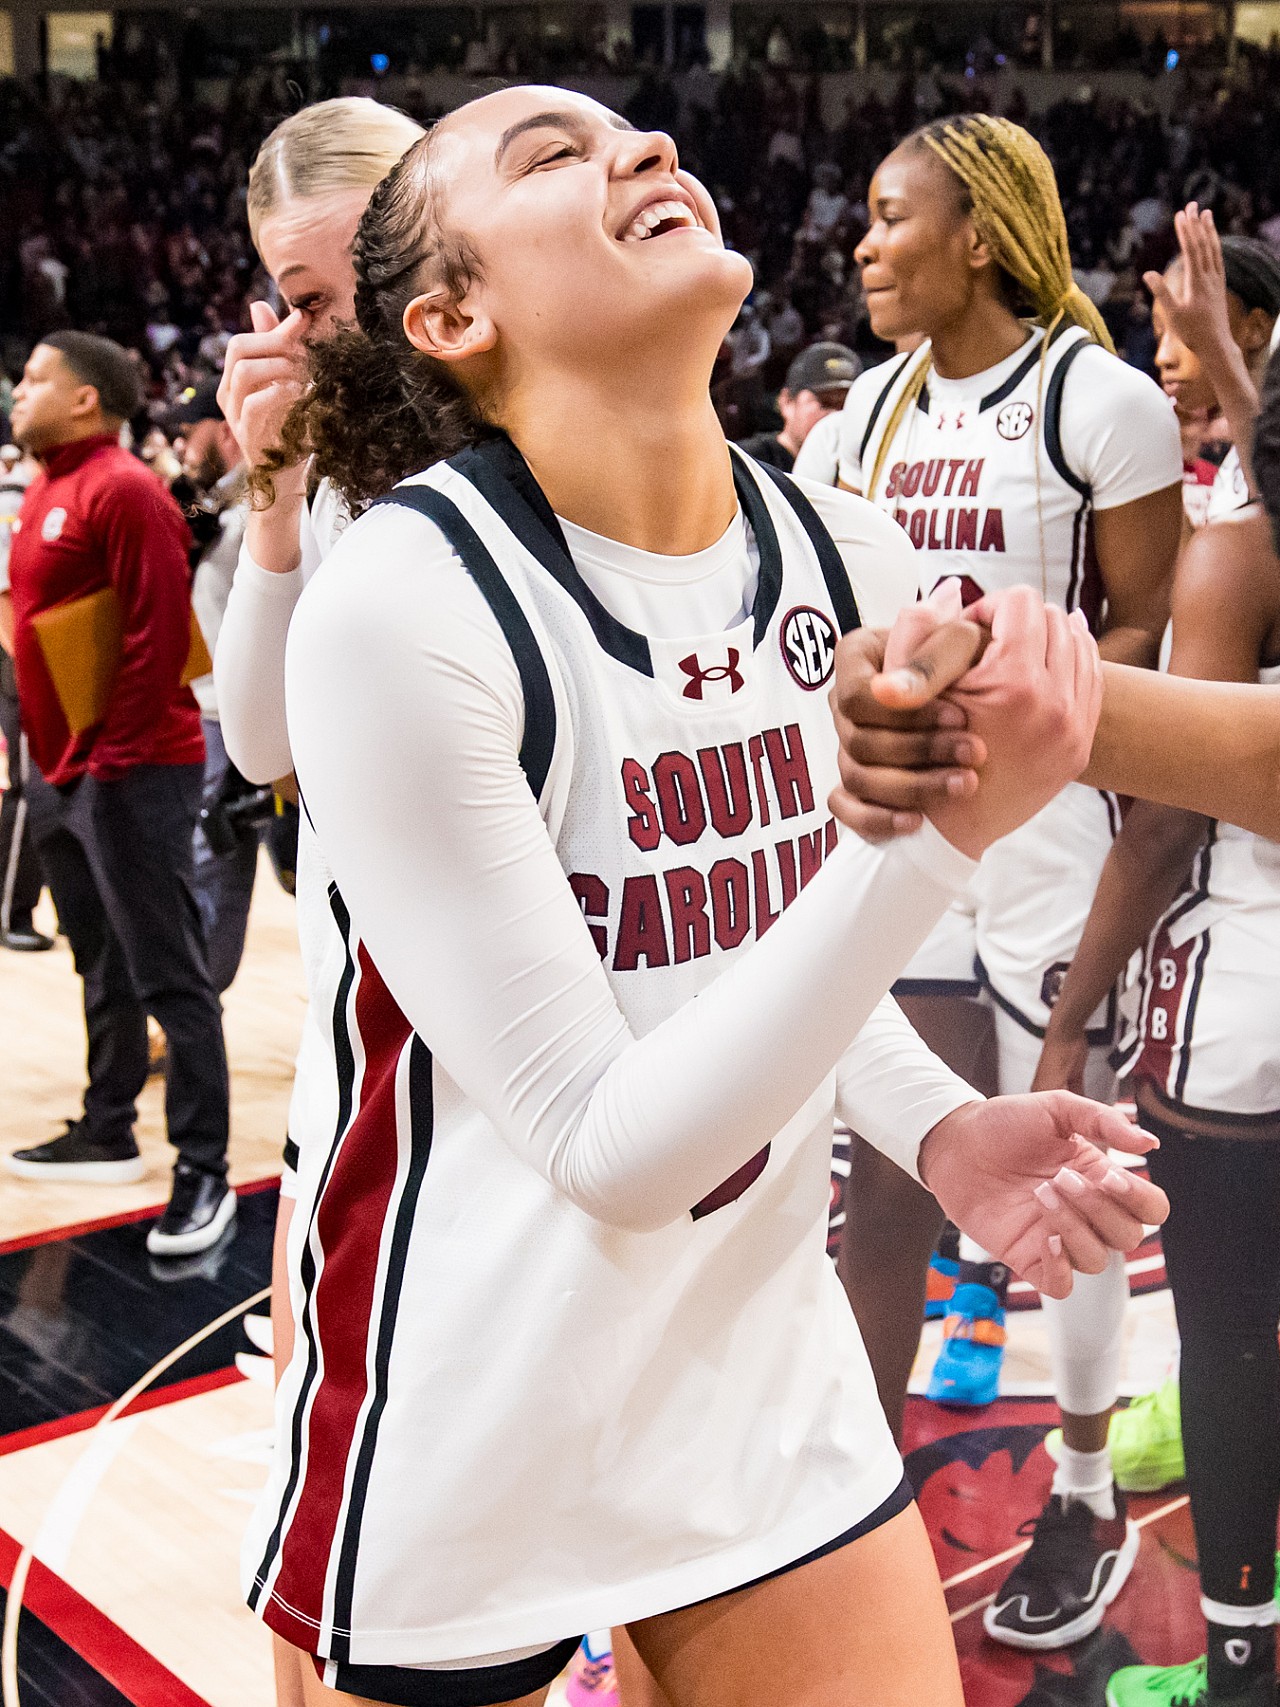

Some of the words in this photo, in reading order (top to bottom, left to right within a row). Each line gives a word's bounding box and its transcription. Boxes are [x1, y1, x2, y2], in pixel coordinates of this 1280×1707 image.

[998, 403, 1032, 439] SEC
[885, 458, 985, 498] SOUTH
[895, 508, 1006, 552] OLINA
[785, 612, 836, 686] SEC
[621, 723, 815, 852] SOUTH
[567, 816, 839, 972] CAROLIN
